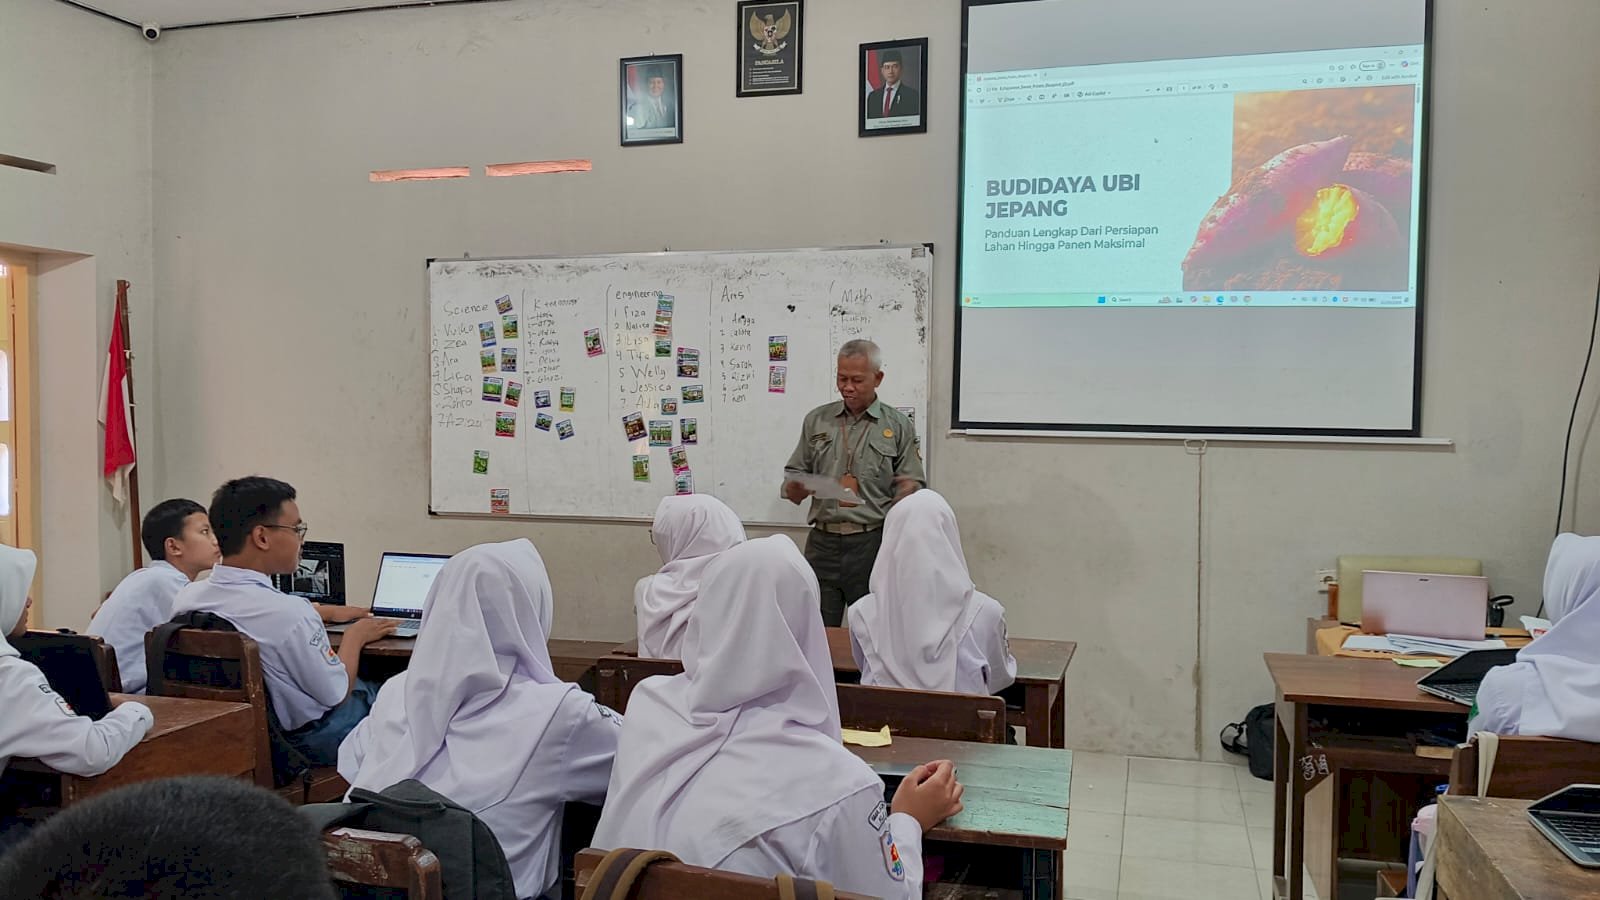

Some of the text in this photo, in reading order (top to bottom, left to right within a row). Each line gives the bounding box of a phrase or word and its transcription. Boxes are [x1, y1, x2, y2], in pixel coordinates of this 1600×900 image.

[986, 173, 1140, 197] BUDIDAYA UBI
[984, 199, 1068, 219] JEPANG
[985, 224, 1159, 239] Panduan Lengkap Dari Persiapan
[984, 238, 1145, 252] Lahan Hingga Panen Maksimal
[443, 302, 489, 316] Science
[631, 363, 667, 380] Welly
[630, 381, 672, 394] Jessica
